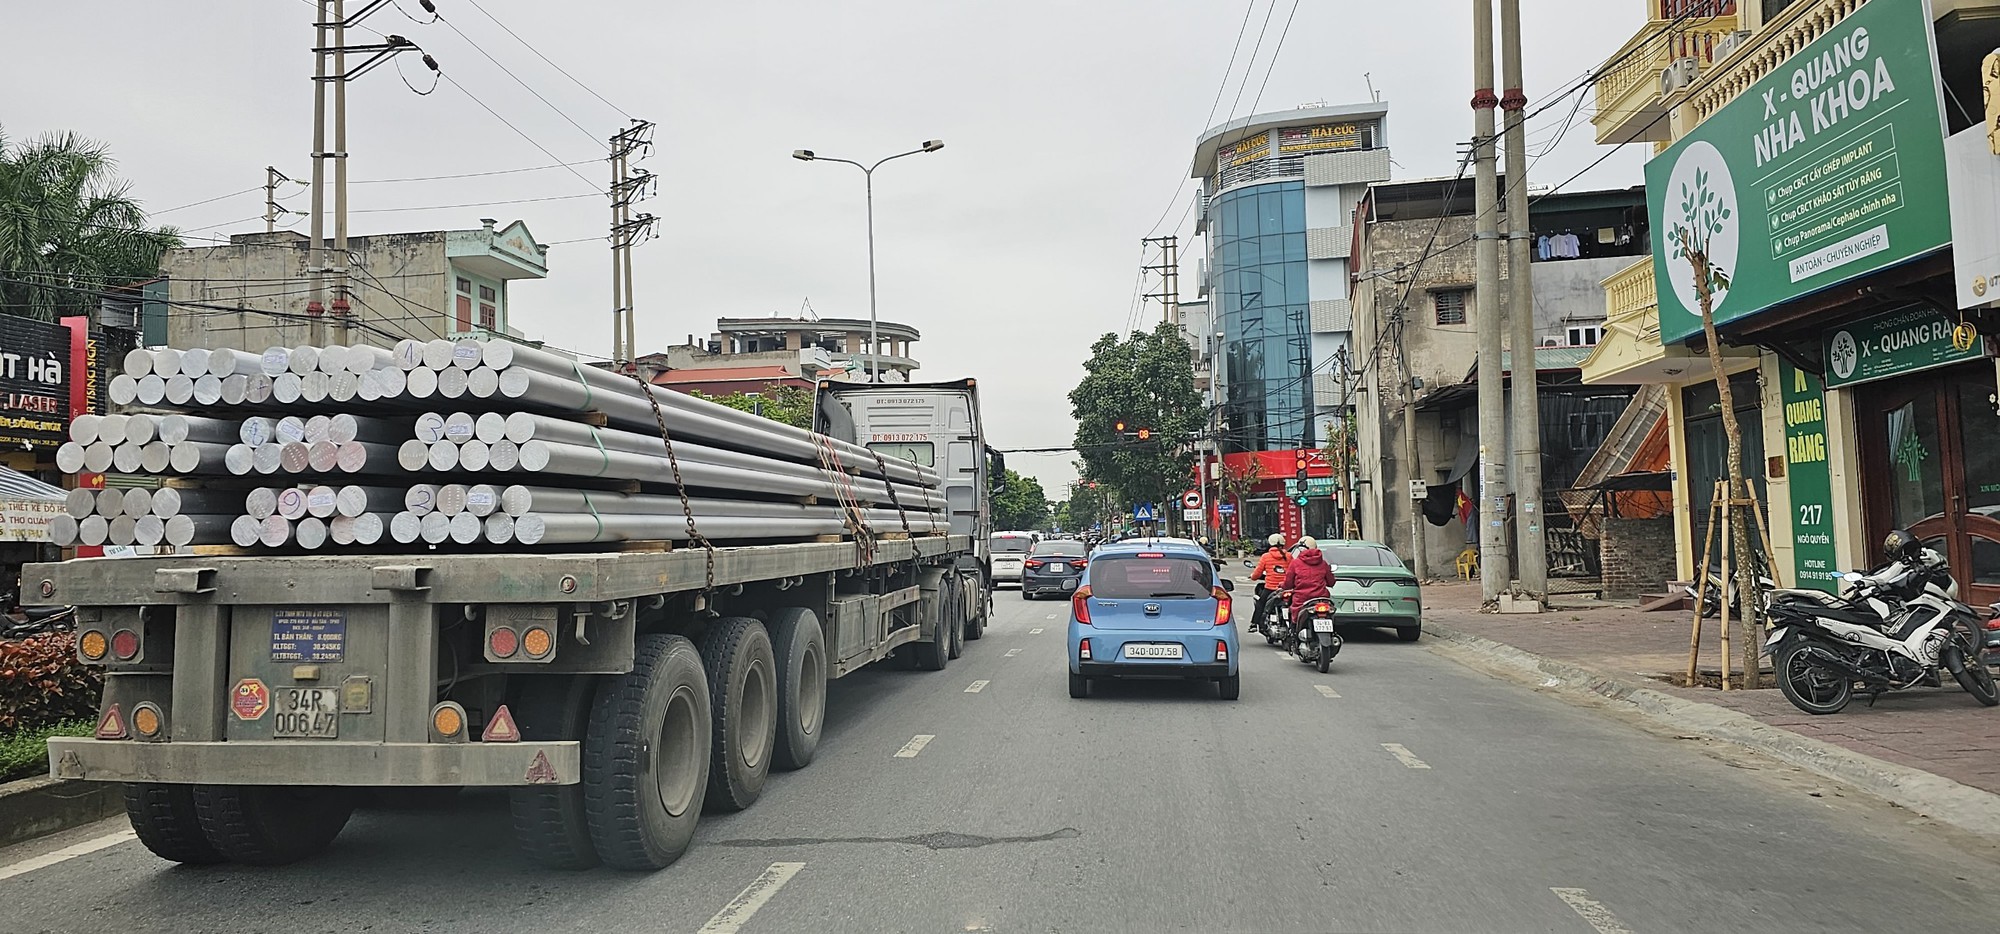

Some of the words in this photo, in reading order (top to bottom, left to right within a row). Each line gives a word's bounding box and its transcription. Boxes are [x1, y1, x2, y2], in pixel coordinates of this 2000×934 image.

[1762, 87, 1777, 121] X
[1791, 26, 1870, 100] QUANG
[1752, 110, 1807, 168] NHA
[1810, 56, 1896, 135] KHOA
[1793, 173, 1809, 189] CBCT
[1822, 156, 1841, 175] GHÉP
[1841, 141, 1873, 166] IMPLANT
[1796, 200, 1812, 215] CBCT
[1832, 184, 1846, 199] SÁT
[1880, 193, 1897, 207] nha
[1795, 263, 1805, 275] AN
[1804, 256, 1823, 272] TOÀN
[1854, 234, 1881, 254] NGHIỆP
[1861, 339, 1871, 358] X
[1881, 324, 1930, 353] QUANG
[1786, 398, 1822, 427] QUANG
[884, 433, 900, 441] 0913
[901, 433, 914, 441] 072
[916, 433, 928, 441] 175
[1139, 429, 1149, 439] 08
[1788, 431, 1825, 464] RĂNG
[1800, 504, 1822, 525] 217
[1799, 571, 1812, 579] 0914
[1804, 560, 1826, 569] HOTLINE
[289, 690, 323, 711] 34R
